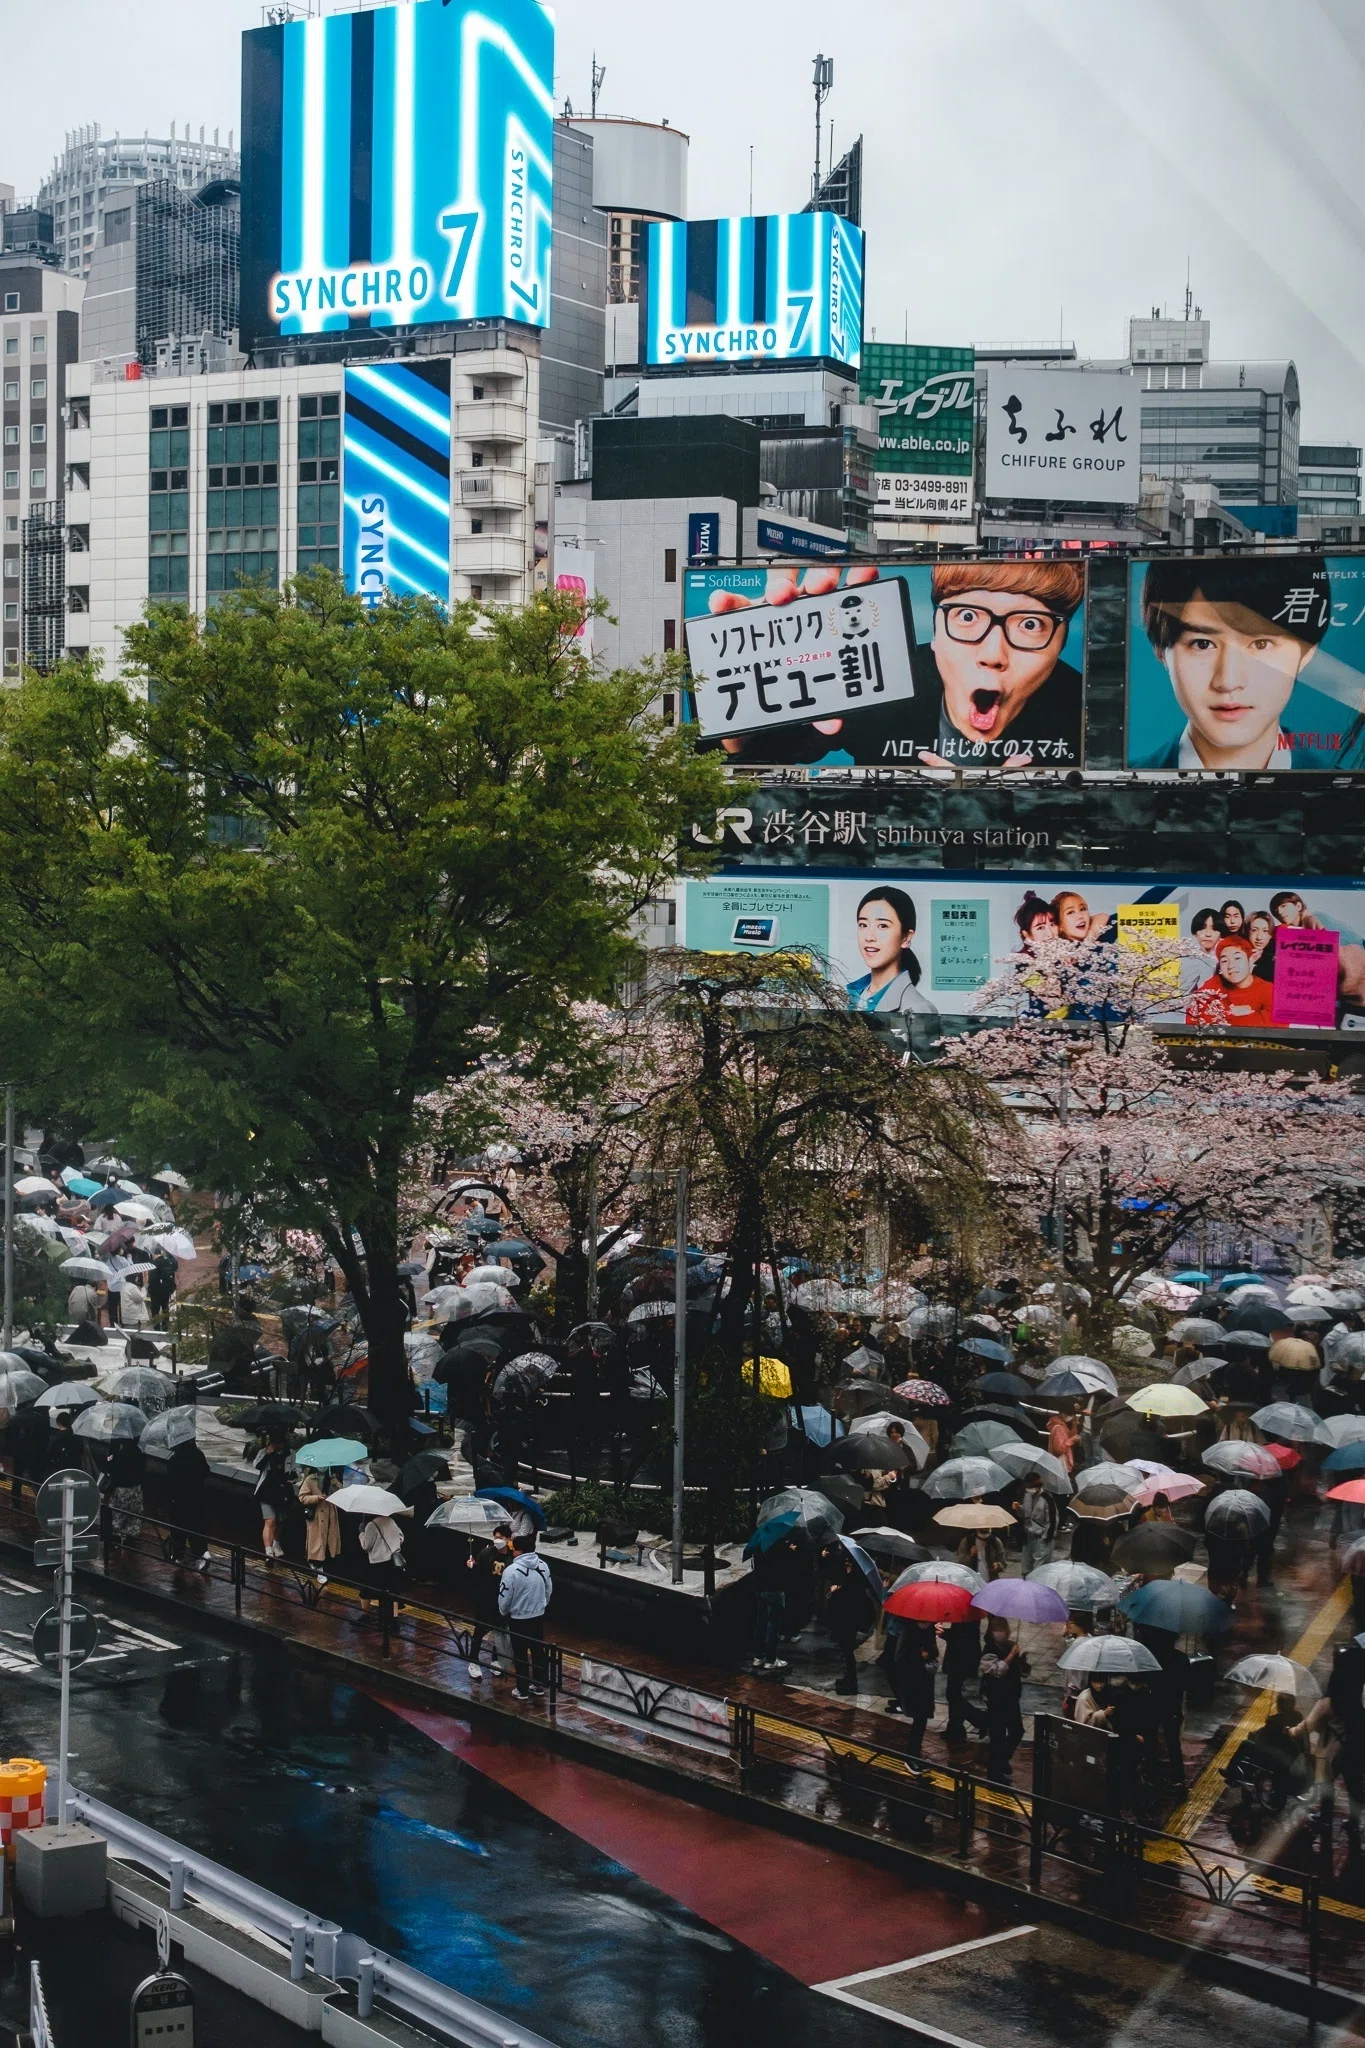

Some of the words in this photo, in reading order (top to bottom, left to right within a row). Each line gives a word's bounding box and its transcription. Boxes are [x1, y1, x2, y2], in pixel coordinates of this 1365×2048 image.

[510, 149, 524, 268] SYNCHRO
[276, 266, 428, 313] SYNCHRO
[442, 212, 479, 297] 7
[831, 228, 839, 324] SYNCHRO
[510, 280, 538, 310] 7
[665, 328, 777, 355] SYNCHRO
[787, 296, 813, 349] 7
[874, 371, 975, 419] エイブル
[1001, 394, 1128, 444] ちふれ
[1001, 453, 1067, 469] CHIFURE
[1072, 457, 1126, 471] GROUP
[894, 479, 968, 494] 03-3499-8911
[766, 527, 784, 540] MIZUHO
[708, 574, 761, 588] SoftBank
[1312, 571, 1358, 579] NETFLIX
[711, 611, 823, 658] ソフトバンク
[716, 641, 885, 721] デビュー割
[1277, 732, 1342, 751] NETFLIX
[762, 808, 868, 845] 渋谷駅
[877, 825, 965, 847] shibuya
[973, 827, 1050, 846] station
[722, 901, 793, 912] 全員にプレゼント!
[151, 1982, 178, 1993] KEIO
